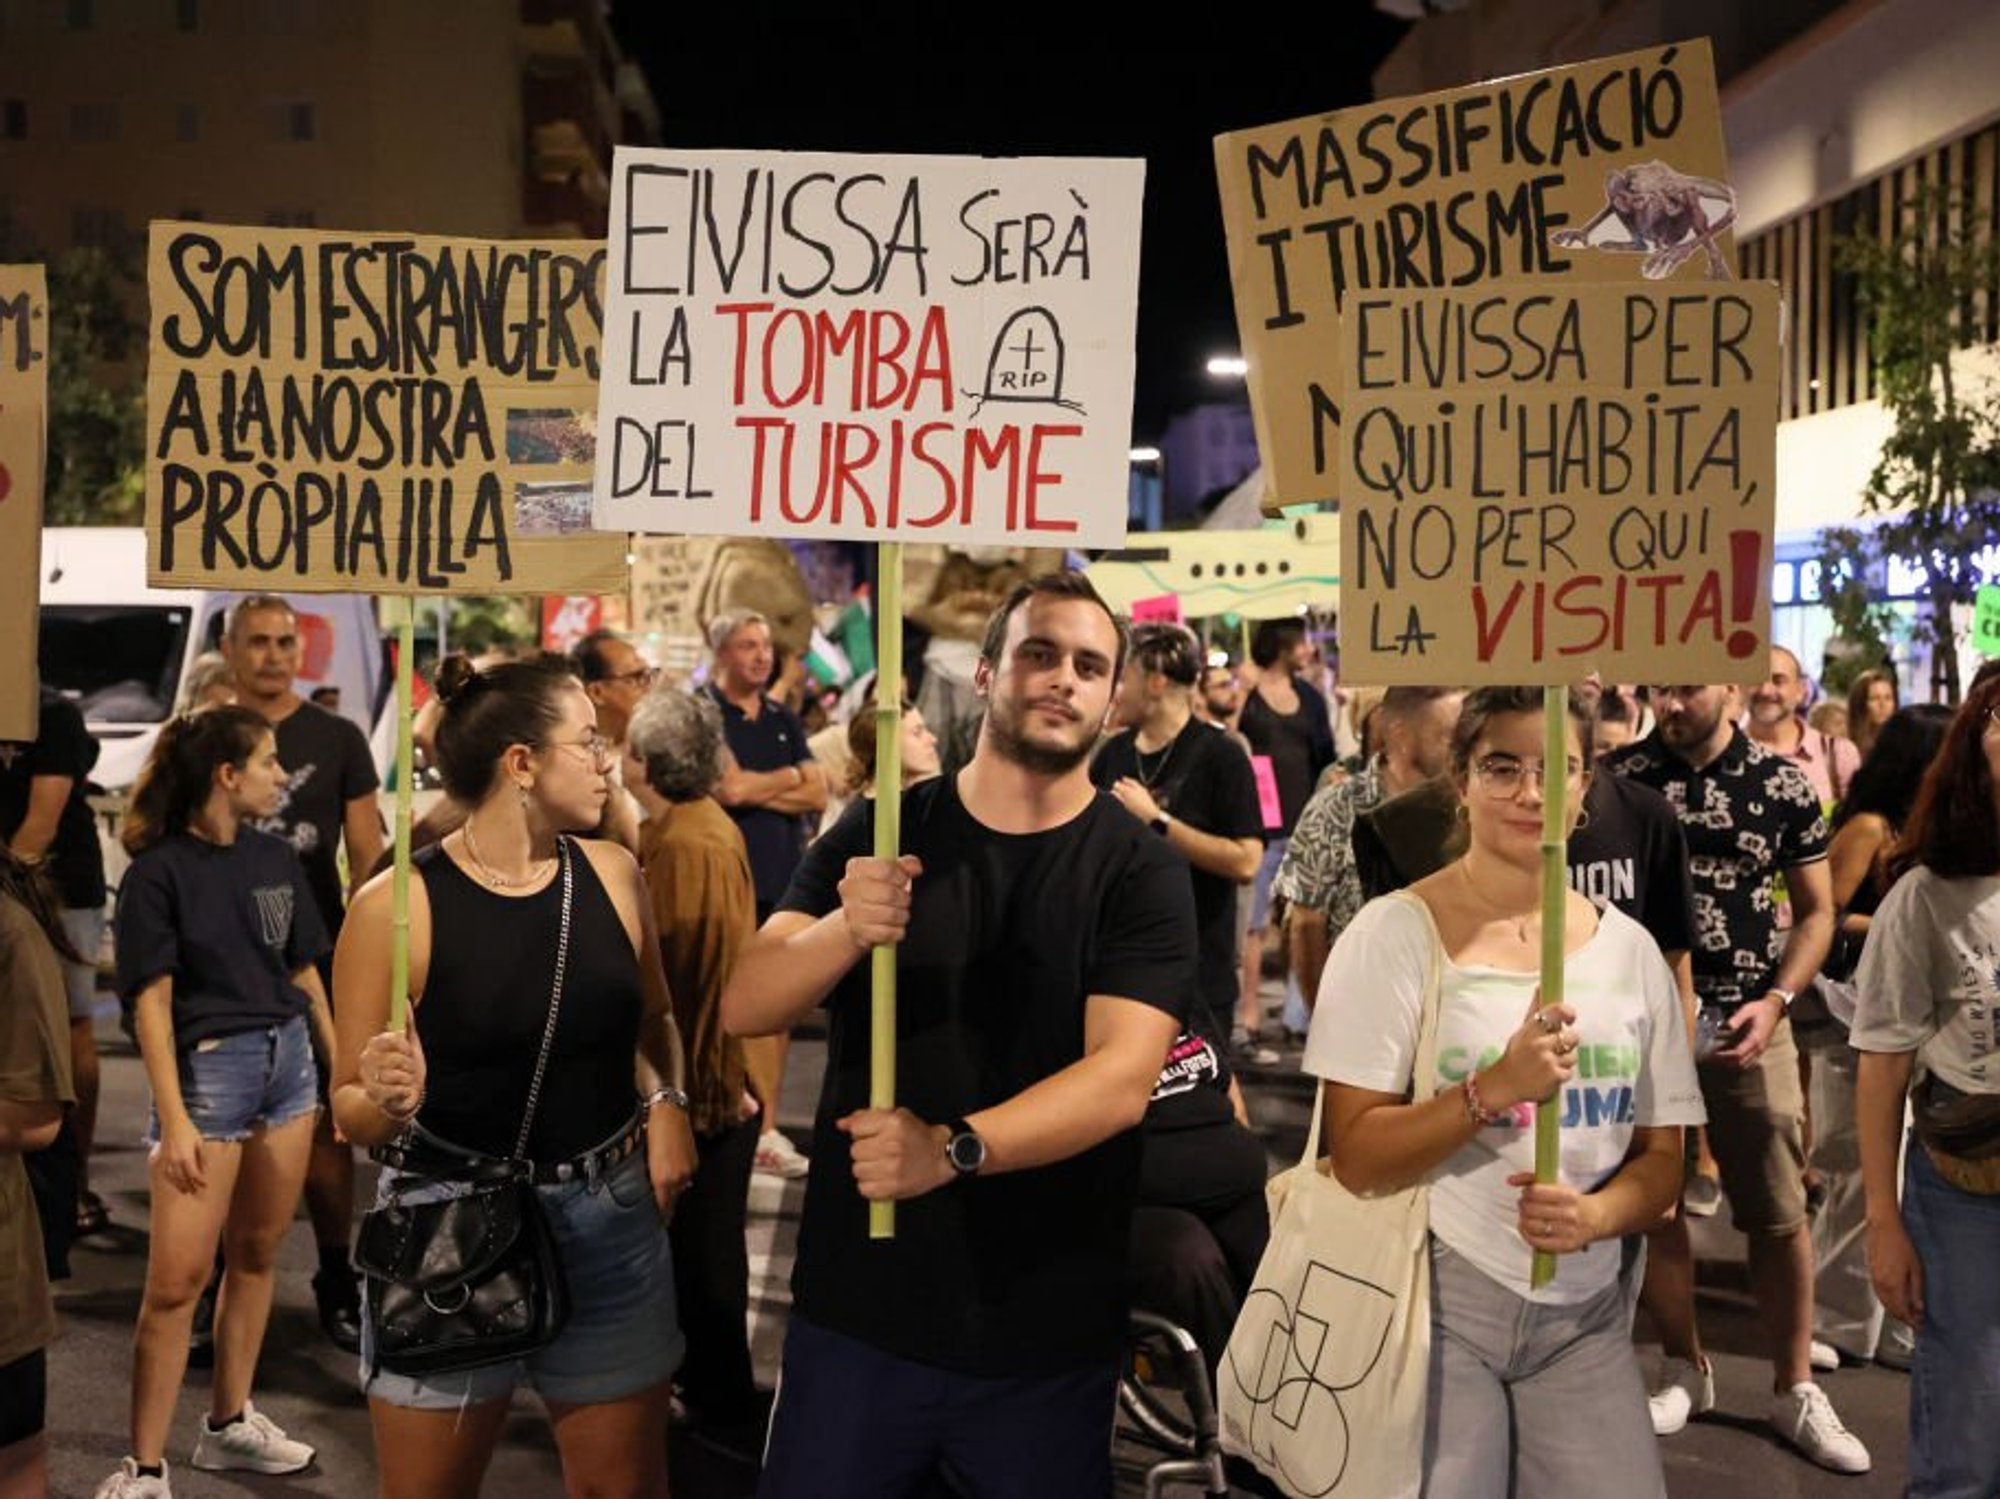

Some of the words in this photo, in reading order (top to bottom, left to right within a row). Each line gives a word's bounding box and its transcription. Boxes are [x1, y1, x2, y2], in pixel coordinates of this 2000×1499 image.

[1247, 46, 1683, 219] MASSIFICACIÓ
[623, 164, 928, 297] EIVISSA
[951, 188, 1090, 286] SERÀ
[1257, 229, 1305, 331] I
[1303, 175, 1572, 314] TURISME
[162, 233, 307, 360] SOM
[629, 306, 691, 386] LA
[716, 302, 954, 412] TOMBA
[1358, 296, 1587, 389] EIVISSA
[1624, 294, 1753, 389] PER
[156, 370, 209, 458] A
[218, 366, 276, 463] LA
[281, 376, 495, 470] NOSTRA
[1000, 370, 1048, 390] RIP
[159, 461, 387, 576] PRÒPIA
[397, 473, 512, 588] ILLA
[611, 416, 713, 499] DEL
[735, 416, 1083, 532] TURISME
[1358, 504, 1456, 589] NO
[1473, 503, 1577, 582] PER
[1609, 506, 1707, 571] QUI
[1370, 602, 1436, 655] LA
[1471, 529, 1761, 662] VISITA!
